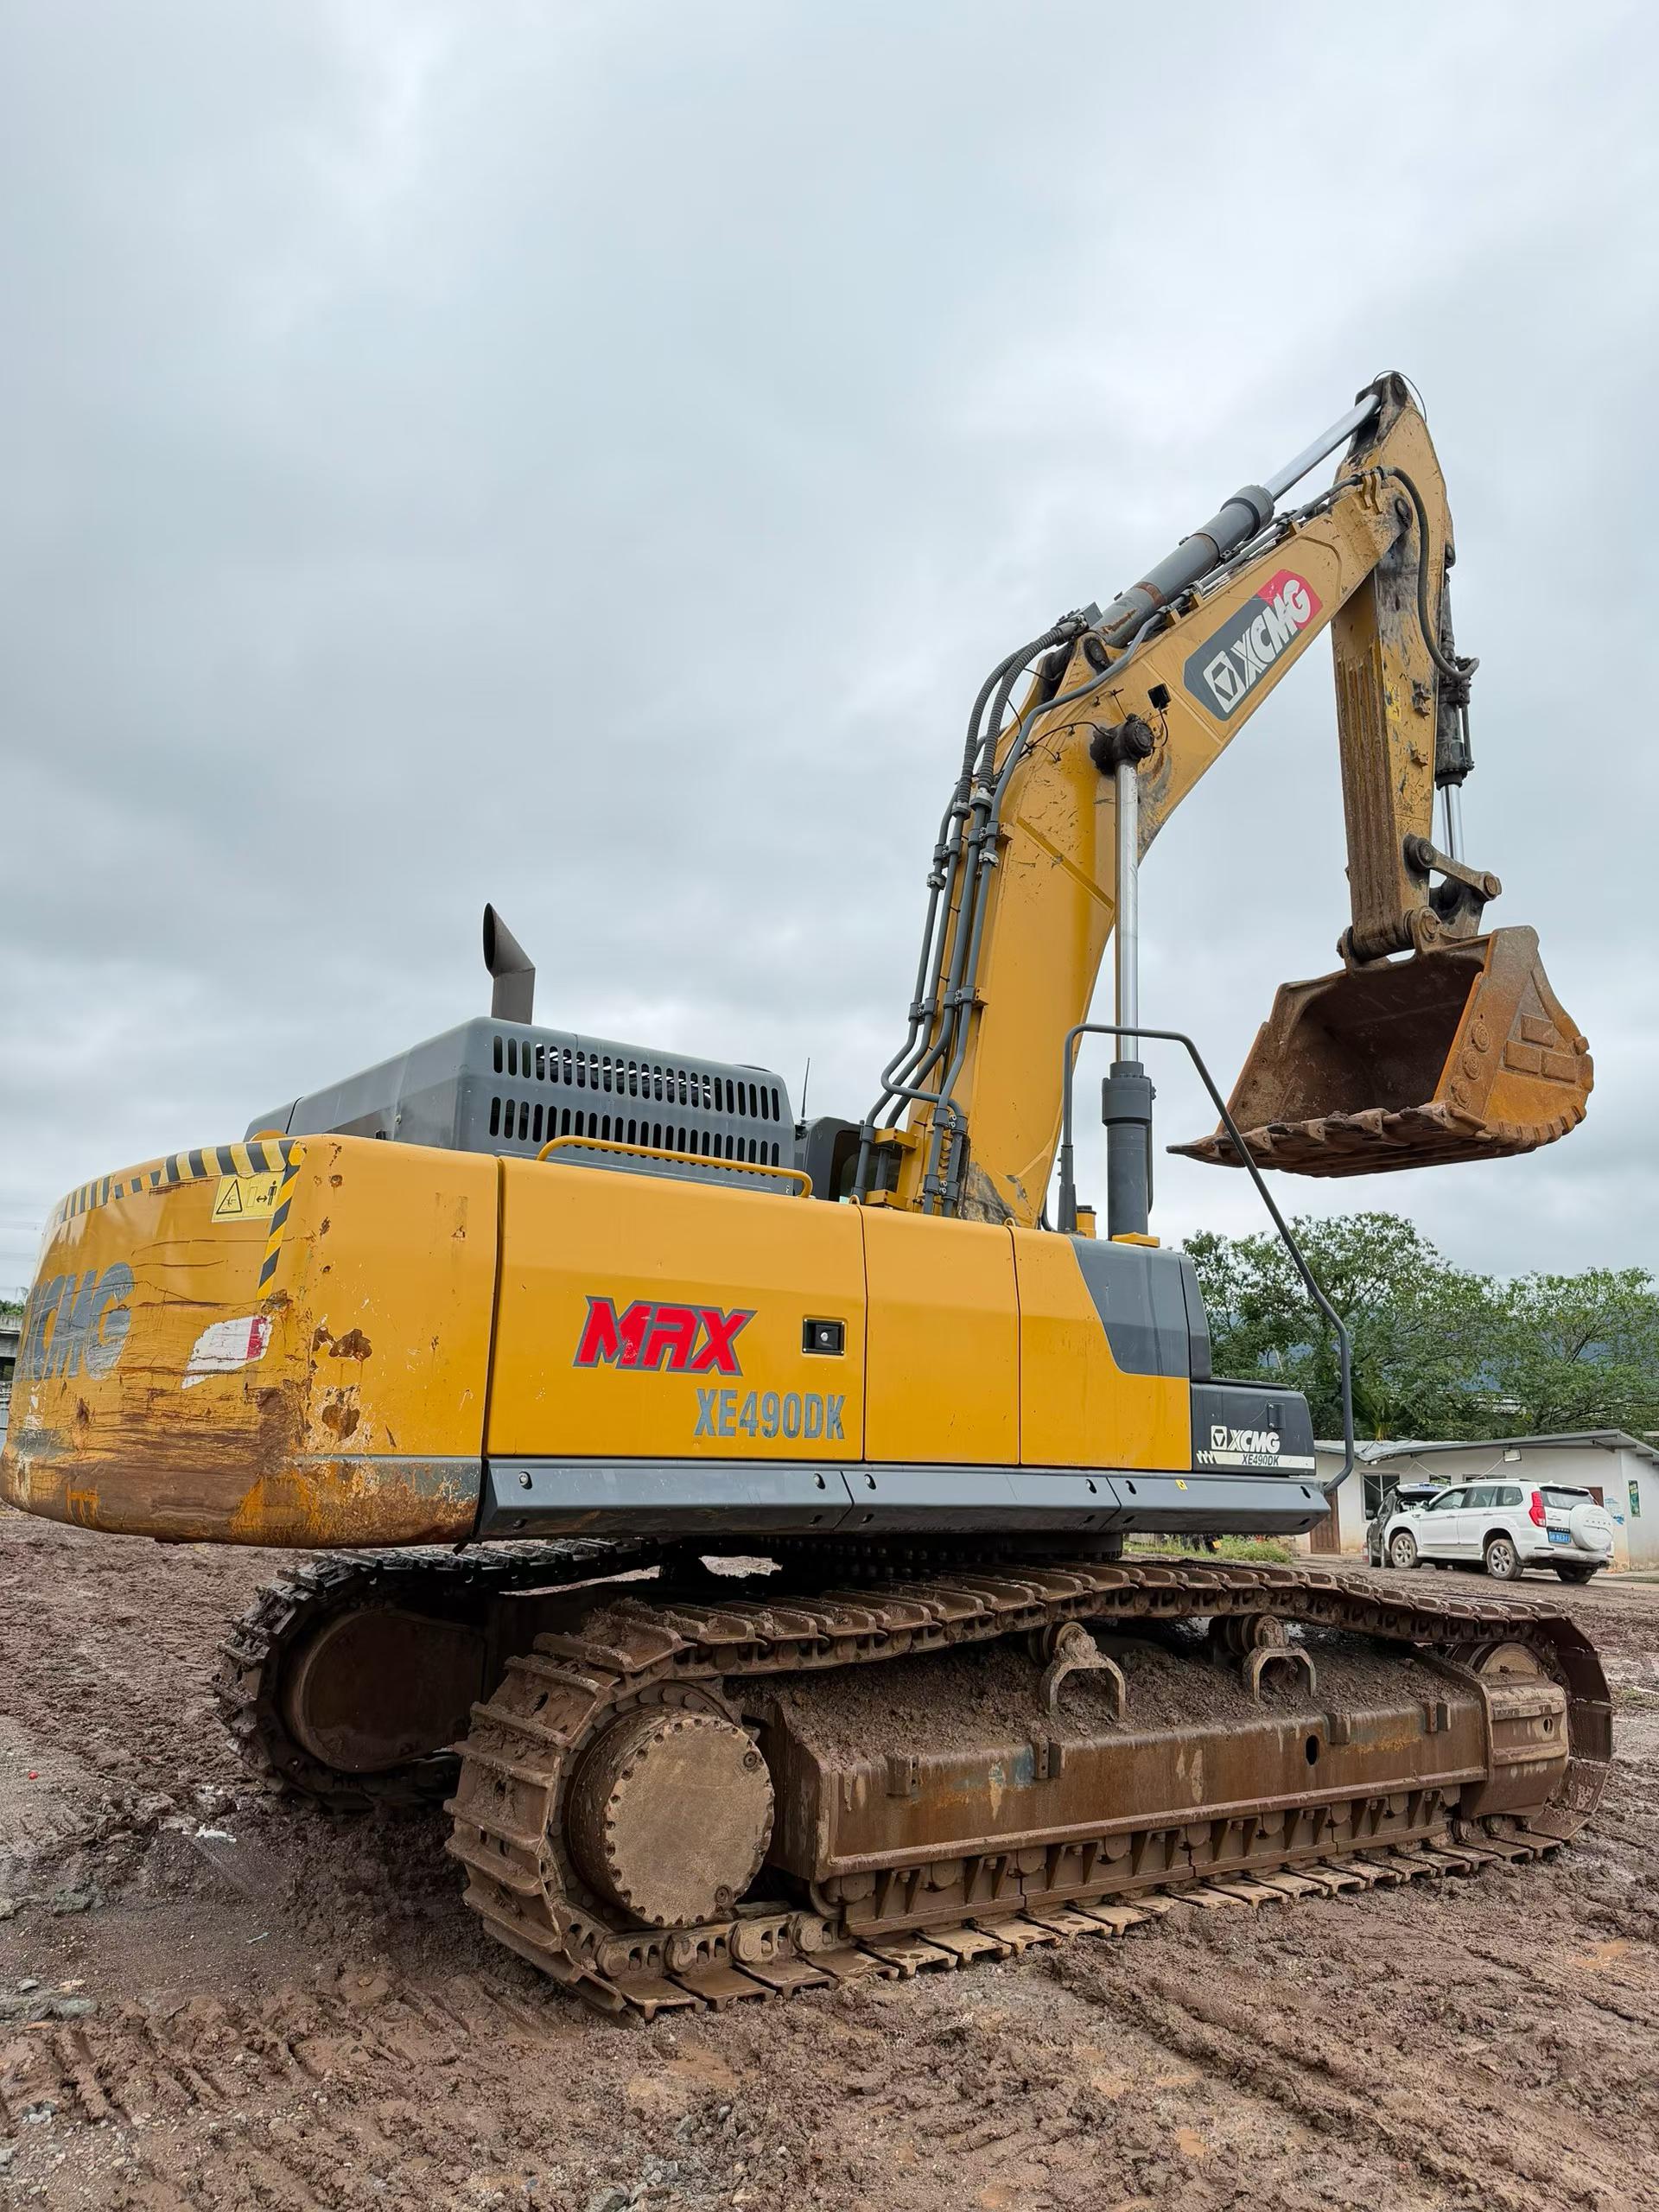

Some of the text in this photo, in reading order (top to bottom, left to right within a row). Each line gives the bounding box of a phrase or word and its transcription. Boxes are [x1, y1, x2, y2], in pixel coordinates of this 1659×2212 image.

[1230, 579, 1311, 690] XCMG
[573, 1295, 758, 1376] MAX
[694, 1388, 846, 1440] XE490DK
[1227, 1429, 1280, 1453] XCMG
[1242, 1453, 1280, 1466] XE490DK
